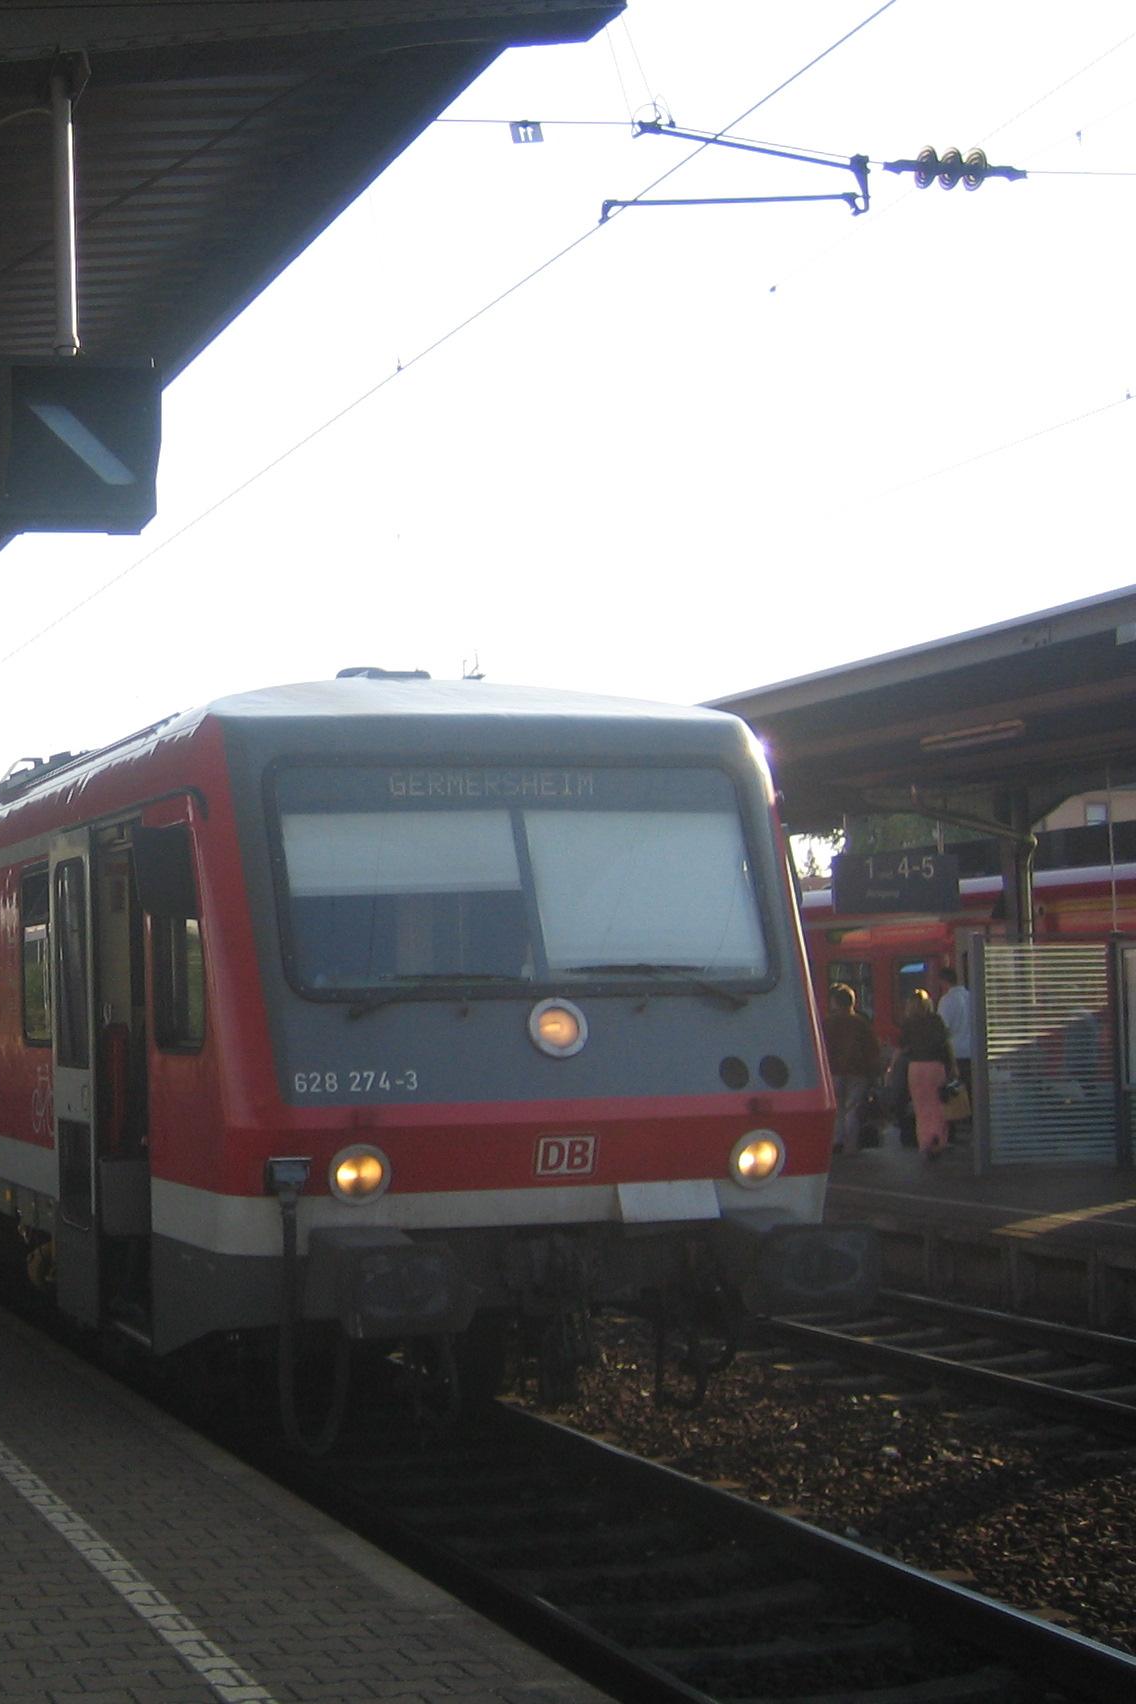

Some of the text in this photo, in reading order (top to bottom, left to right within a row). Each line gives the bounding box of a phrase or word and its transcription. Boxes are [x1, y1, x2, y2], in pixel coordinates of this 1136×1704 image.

[390, 768, 595, 797] GERMERSHEIM
[865, 856, 934, 879] 1 4-5
[294, 1070, 419, 1093] 628 274-3
[541, 1139, 591, 1172] DB
